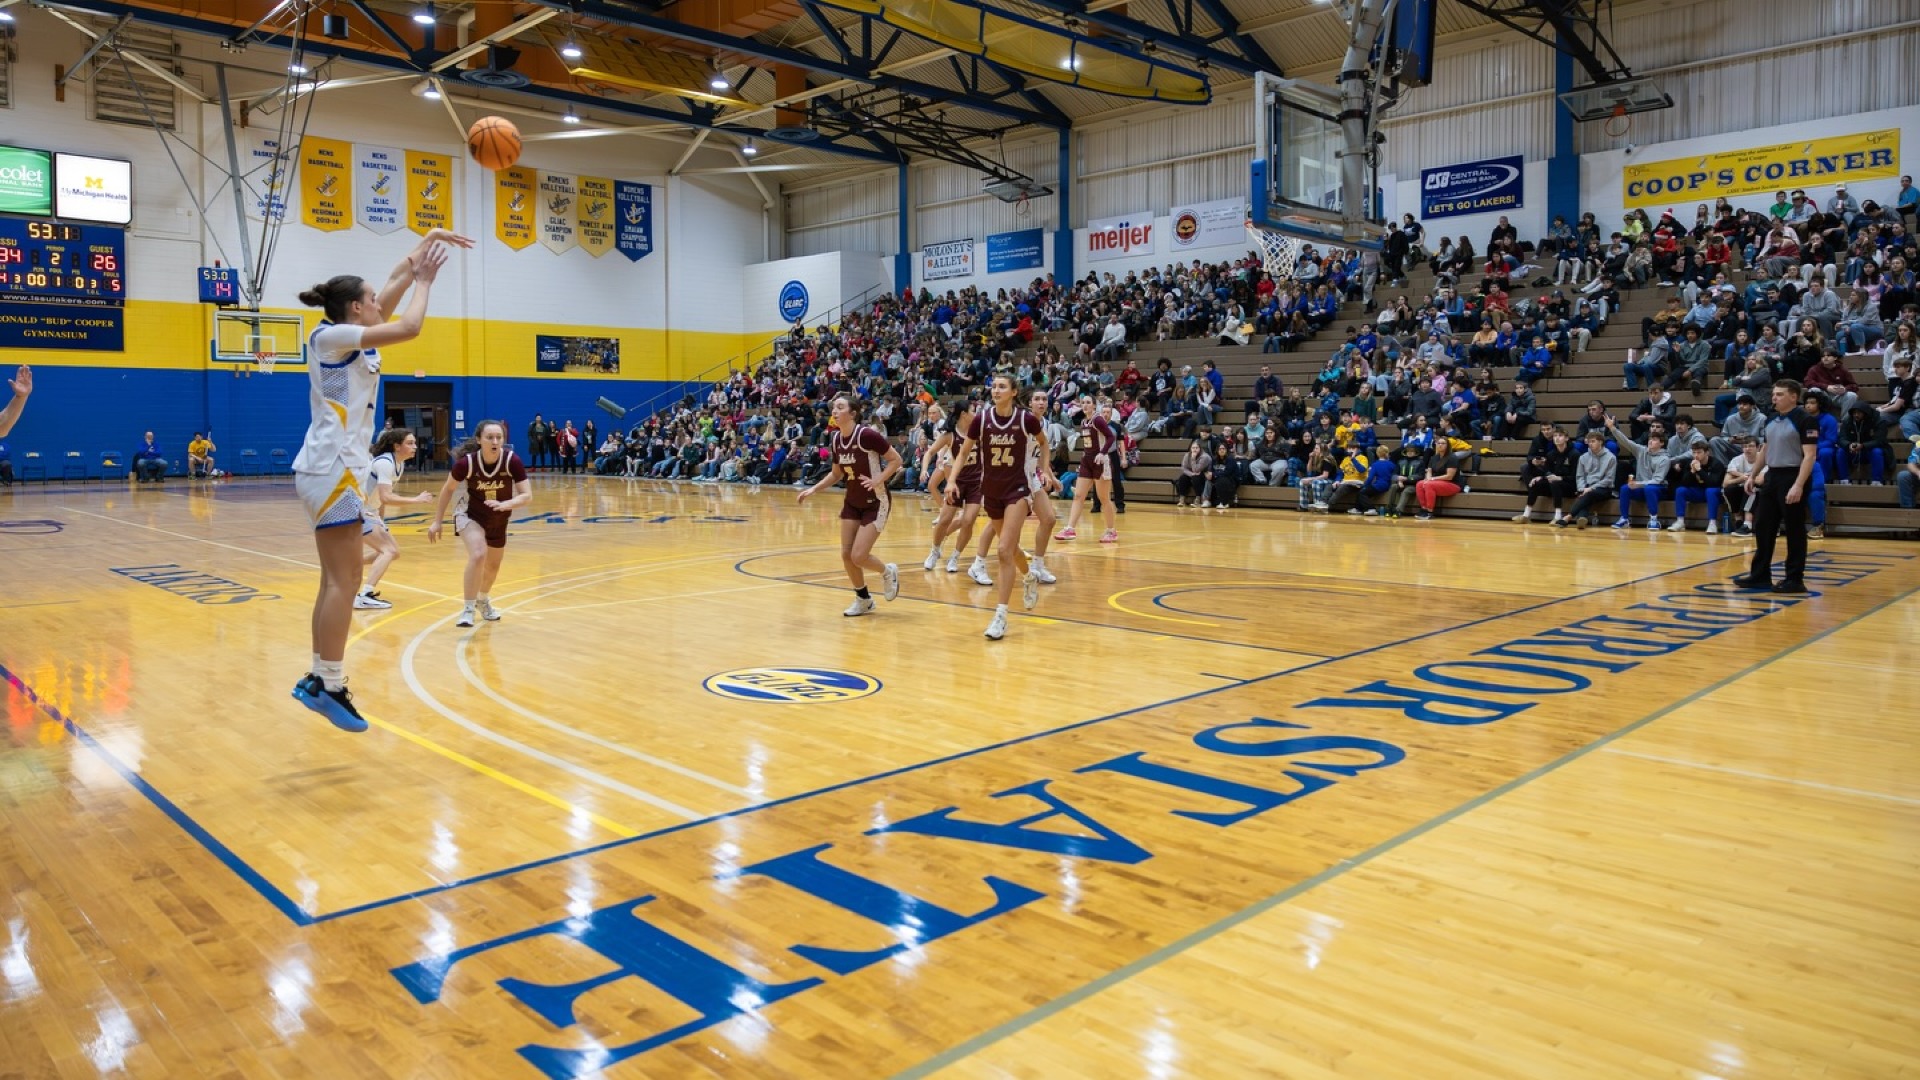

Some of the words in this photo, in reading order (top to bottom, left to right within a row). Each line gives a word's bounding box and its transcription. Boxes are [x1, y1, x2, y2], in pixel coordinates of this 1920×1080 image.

[318, 149, 334, 157] MENS
[372, 152, 387, 160] MENS
[308, 159, 344, 169] BASKETBALL
[362, 161, 397, 171] BASKETBALL
[421, 159, 437, 167] MENS
[412, 167, 446, 178] BASKETBALL
[1451, 169, 1490, 180] CENTRAL
[1628, 168, 1734, 197] COOP'S
[1744, 148, 1894, 182] CORNER
[85, 176, 103, 189] M
[500, 180, 532, 190] BASKETBALL
[547, 175, 569, 185] WOMENS
[1451, 178, 1477, 186] SAVINGS
[1479, 174, 1498, 182] BANK
[540, 183, 576, 195] VOLLEYBALL
[579, 188, 612, 199] VOLLEYBALL
[105, 191, 128, 201] Health
[372, 197, 389, 205] GLIAC
[617, 192, 650, 204] VOLLEYBALL
[1428, 202, 1454, 213] LET'S
[1457, 200, 1471, 210] GO
[1474, 195, 1515, 208] LAKERS!
[366, 206, 397, 215] CHAMPIONS
[544, 224, 572, 234] CHAMPION
[620, 232, 648, 242] CHAMPION
[1089, 221, 1152, 252] meijer
[89, 245, 114, 253] GUEST
[924, 242, 973, 257] MOLONEY'S
[51, 252, 61, 265] 2
[94, 254, 116, 270] 26
[933, 255, 962, 268] ALLEY
[14, 274, 21, 284] 3
[27, 273, 46, 286] 00
[90, 280, 97, 288] 3
[203, 270, 229, 281] 53.0
[216, 282, 232, 297] 14
[75, 318, 114, 328] COOPER
[23, 329, 88, 339] GYMNASIUM
[990, 434, 1017, 445] Walsh
[990, 447, 1015, 467] 24
[109, 564, 282, 604] LAKERS
[1292, 583, 1823, 727] SUPERIOR
[727, 673, 848, 698] GLIAC
[392, 716, 1405, 1080] STATE
